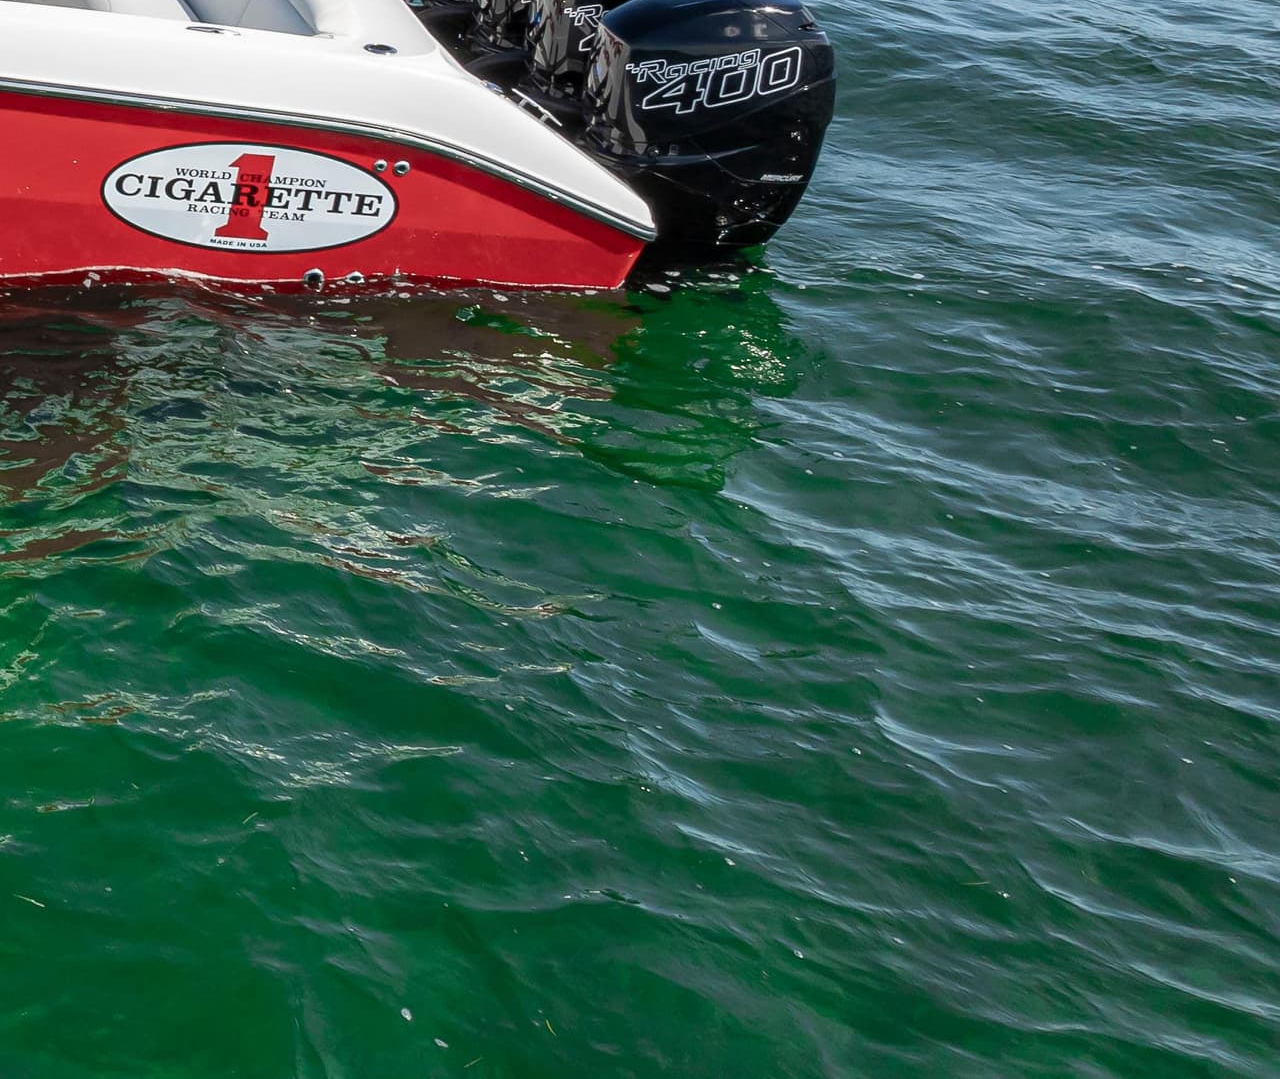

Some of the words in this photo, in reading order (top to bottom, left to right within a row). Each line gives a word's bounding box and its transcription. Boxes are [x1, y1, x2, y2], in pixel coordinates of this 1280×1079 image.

[636, 48, 761, 84] Racing
[642, 46, 802, 114] 400
[114, 173, 384, 218] CIGARETTE
[175, 167, 232, 181] WORLD
[239, 173, 328, 189] CHAMPION
[186, 203, 250, 218] RACING
[260, 209, 306, 222] TEAM
[213, 153, 276, 241] 1
[210, 238, 234, 246] MADE
